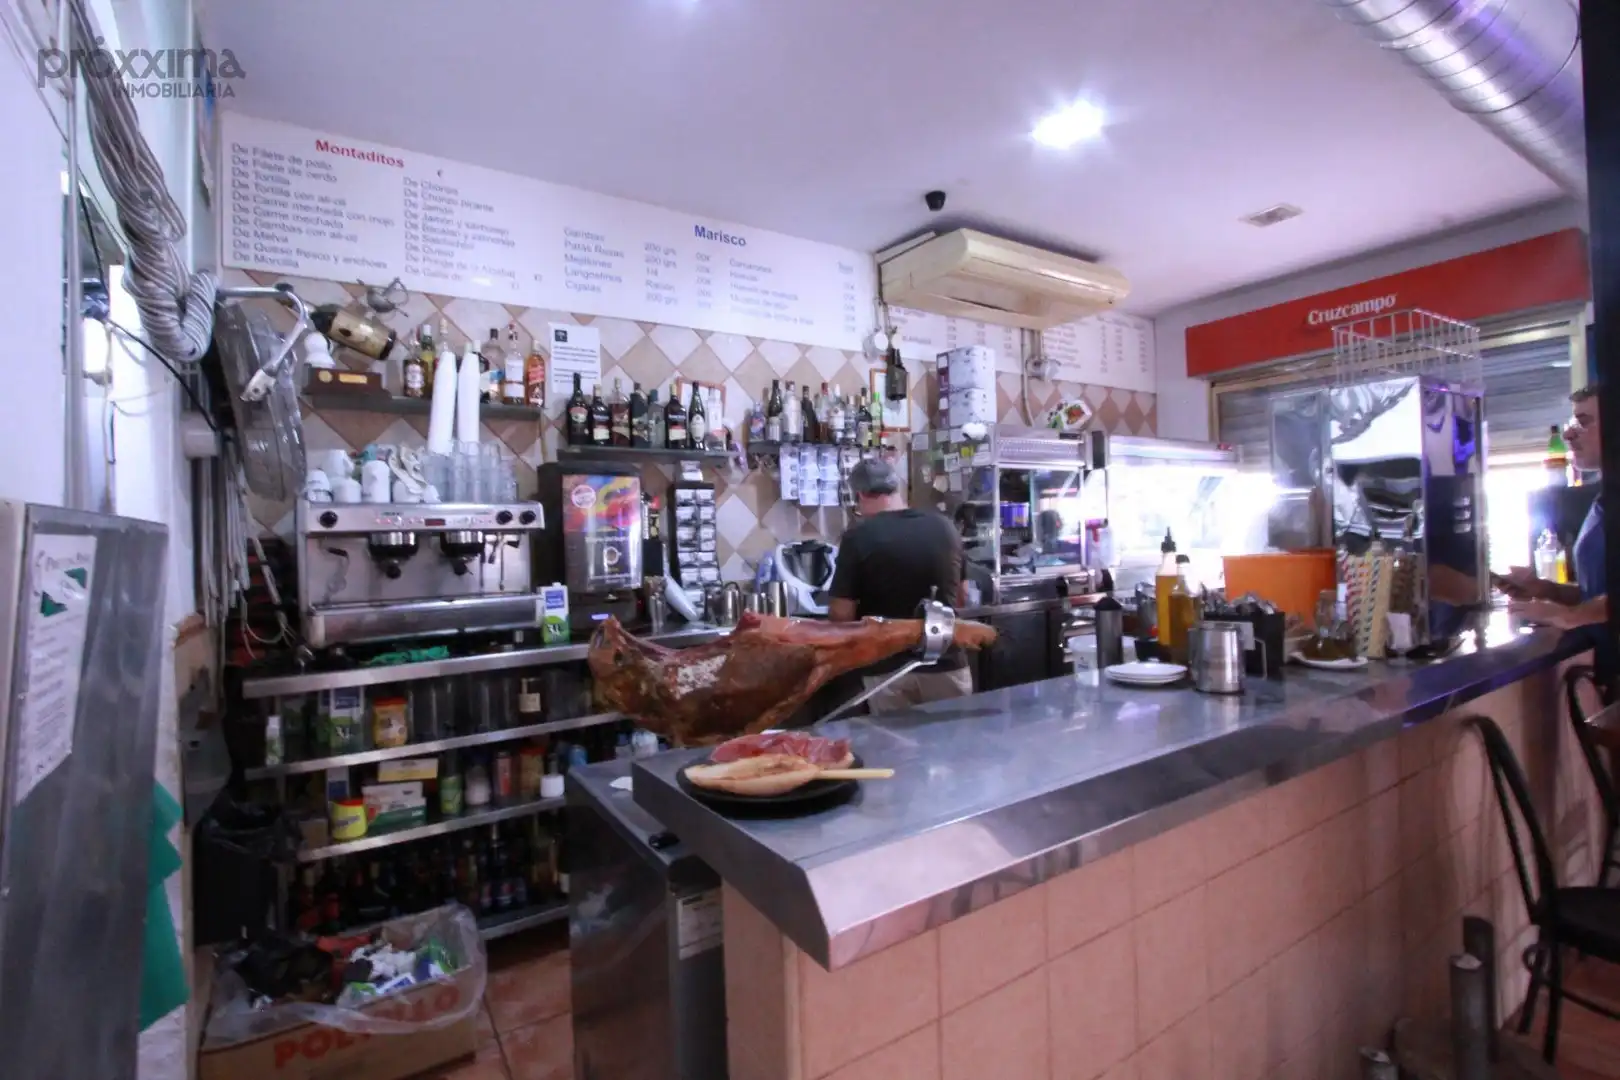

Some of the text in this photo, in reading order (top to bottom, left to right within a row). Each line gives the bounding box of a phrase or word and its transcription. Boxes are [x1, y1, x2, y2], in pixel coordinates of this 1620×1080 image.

[315, 139, 404, 168] Montaditos
[694, 224, 746, 248] Marisco
[1308, 294, 1396, 324] Cruzcampo
